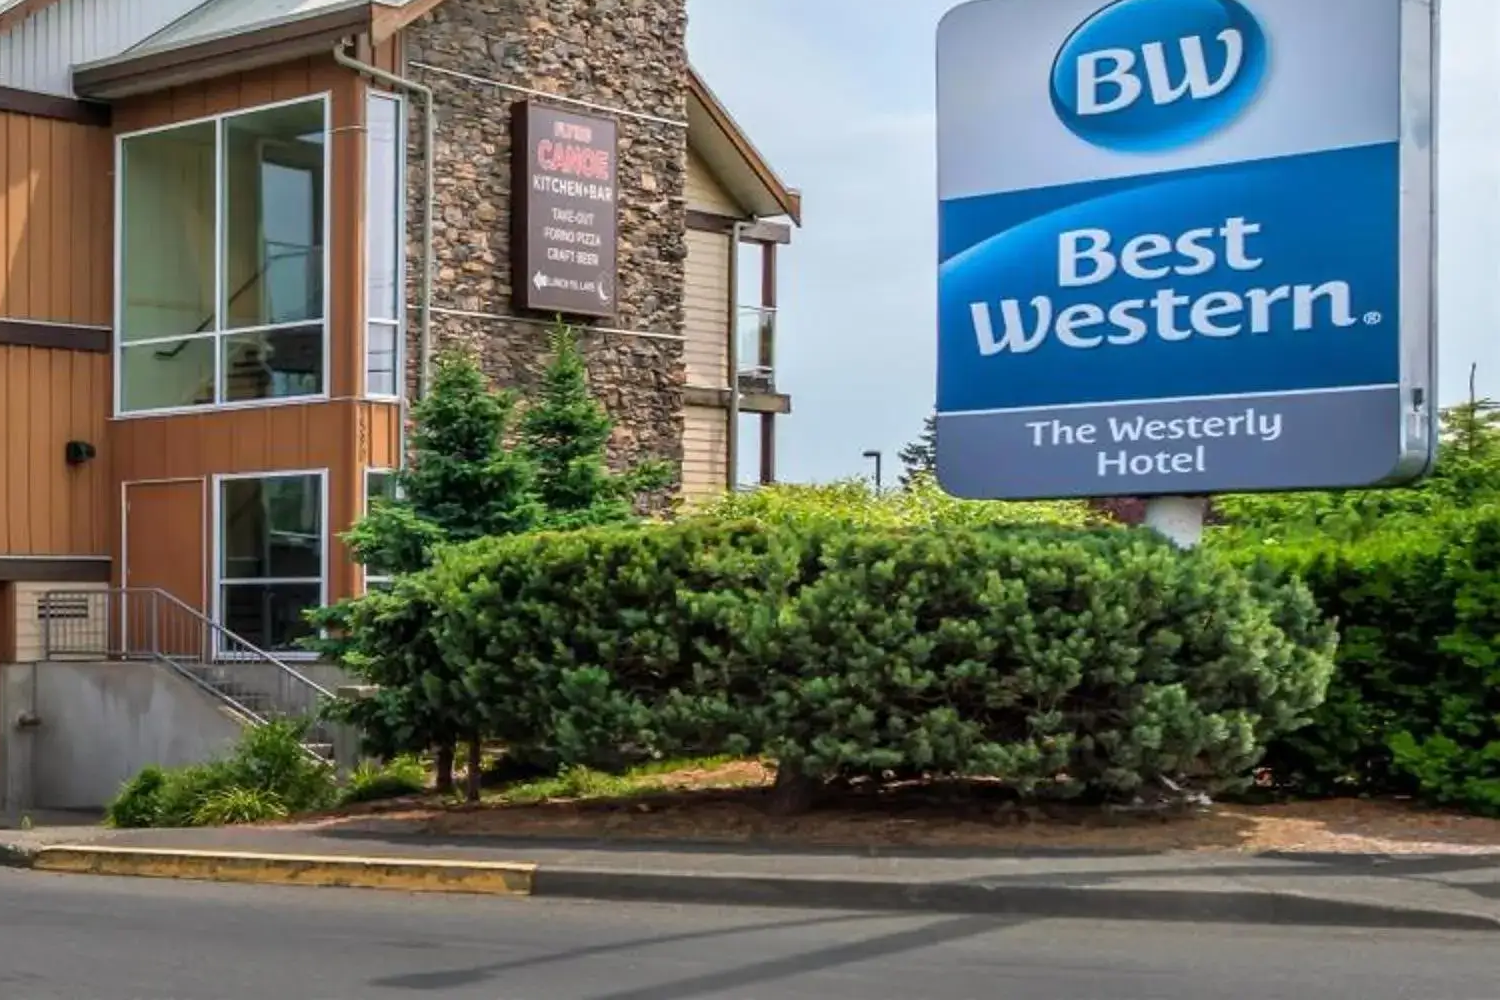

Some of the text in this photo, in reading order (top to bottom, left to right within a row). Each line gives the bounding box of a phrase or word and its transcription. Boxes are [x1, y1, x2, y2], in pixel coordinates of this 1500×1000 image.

[1075, 28, 1244, 116] BW
[1058, 217, 1263, 287] Best
[970, 280, 1357, 356] Western
[1025, 408, 1283, 446] The Westerly
[1097, 445, 1206, 476] Hotel
